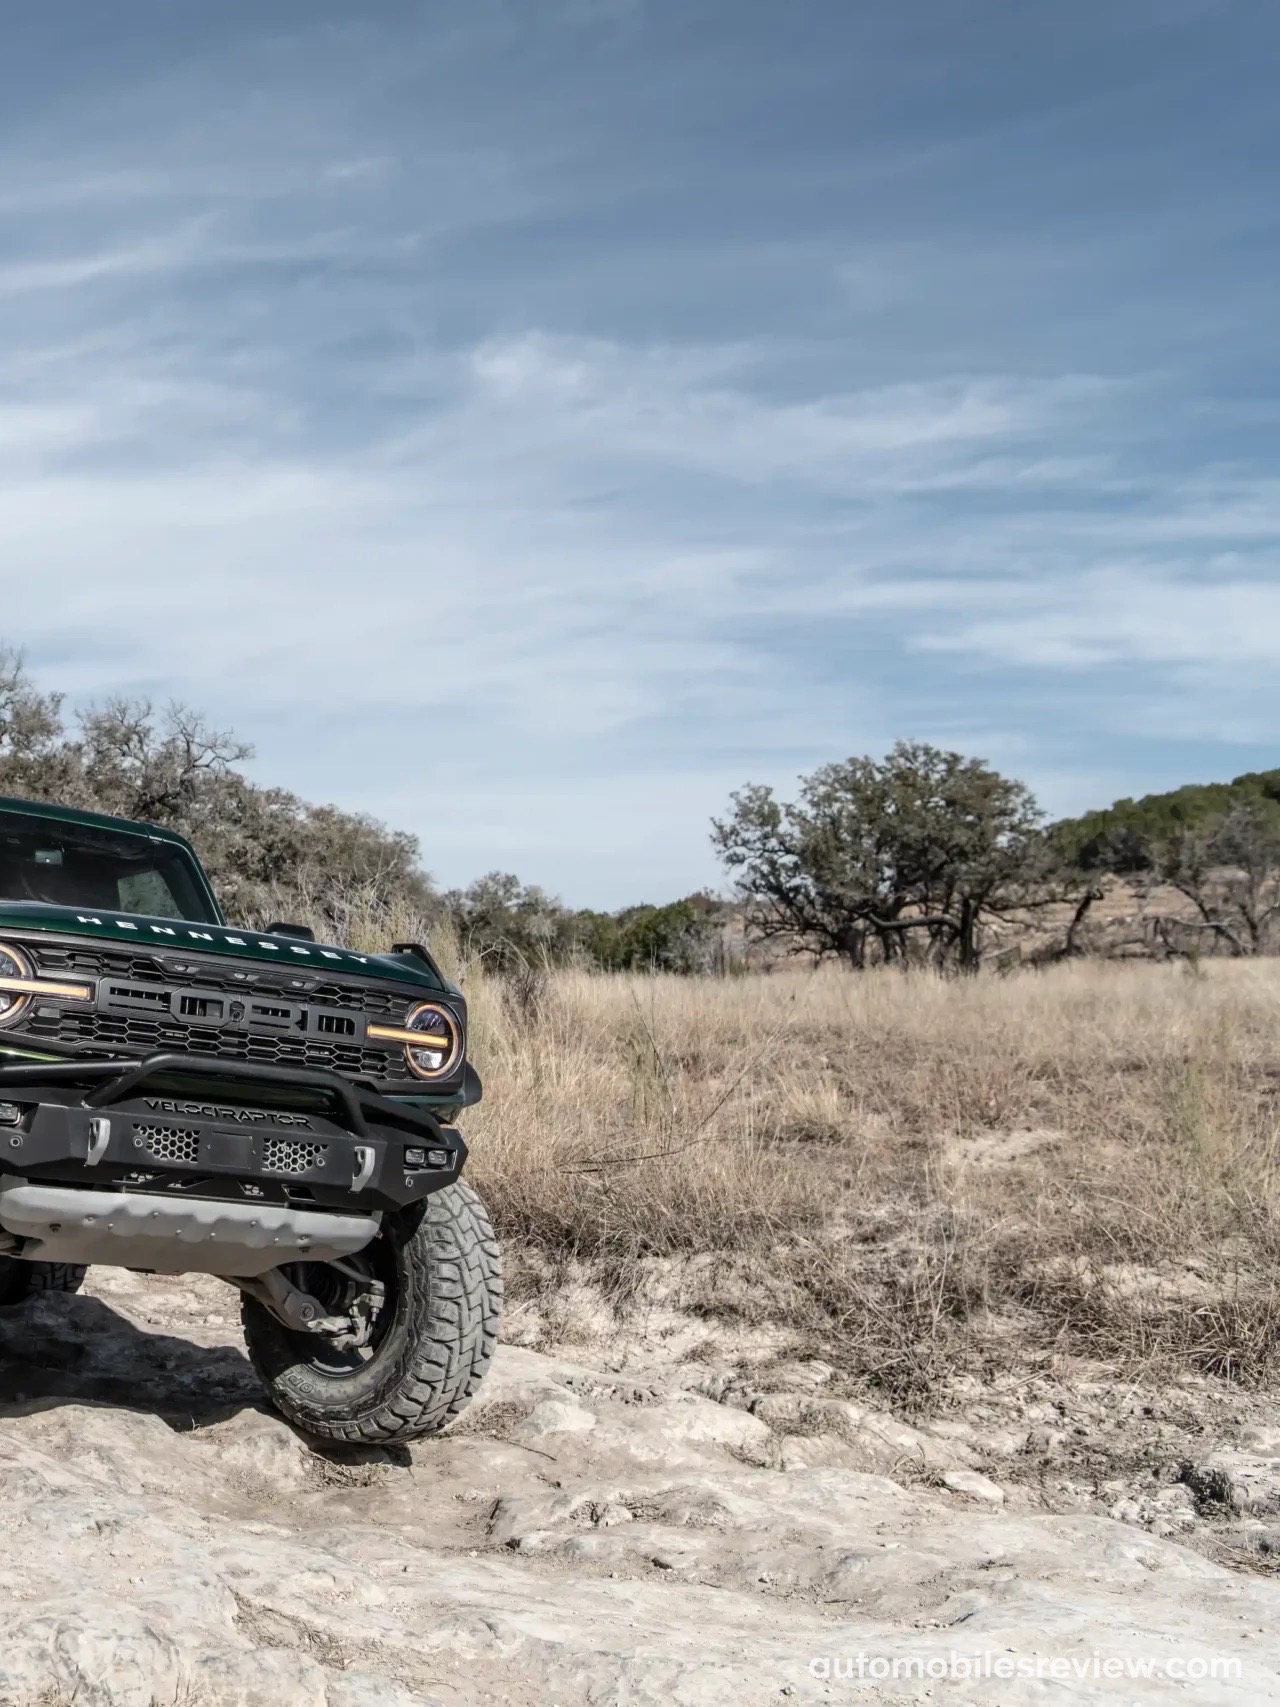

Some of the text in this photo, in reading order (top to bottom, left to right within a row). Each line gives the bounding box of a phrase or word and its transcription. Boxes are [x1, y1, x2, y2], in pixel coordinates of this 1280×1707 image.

[76, 915, 369, 964] HENNESSEY
[98, 976, 368, 1047] FORD
[143, 1097, 316, 1132] VELOCIRAPTOR
